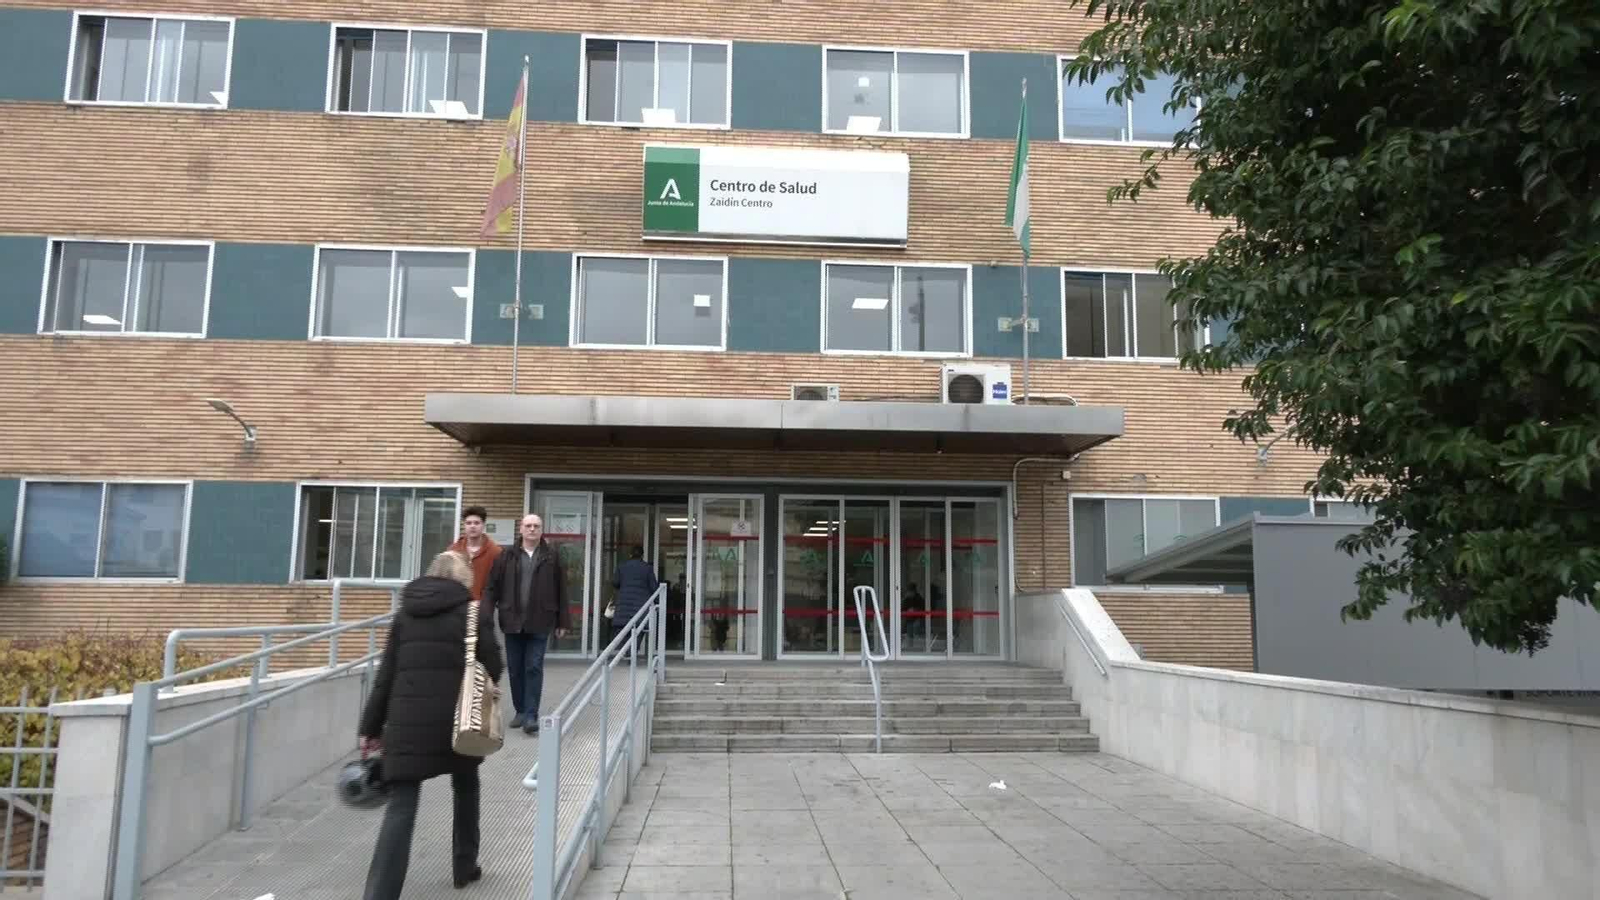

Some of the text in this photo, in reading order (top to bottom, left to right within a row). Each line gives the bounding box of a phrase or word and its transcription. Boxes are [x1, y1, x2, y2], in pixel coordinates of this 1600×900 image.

[710, 179, 817, 195] Centro de Salud
[741, 198, 773, 208] Centro
